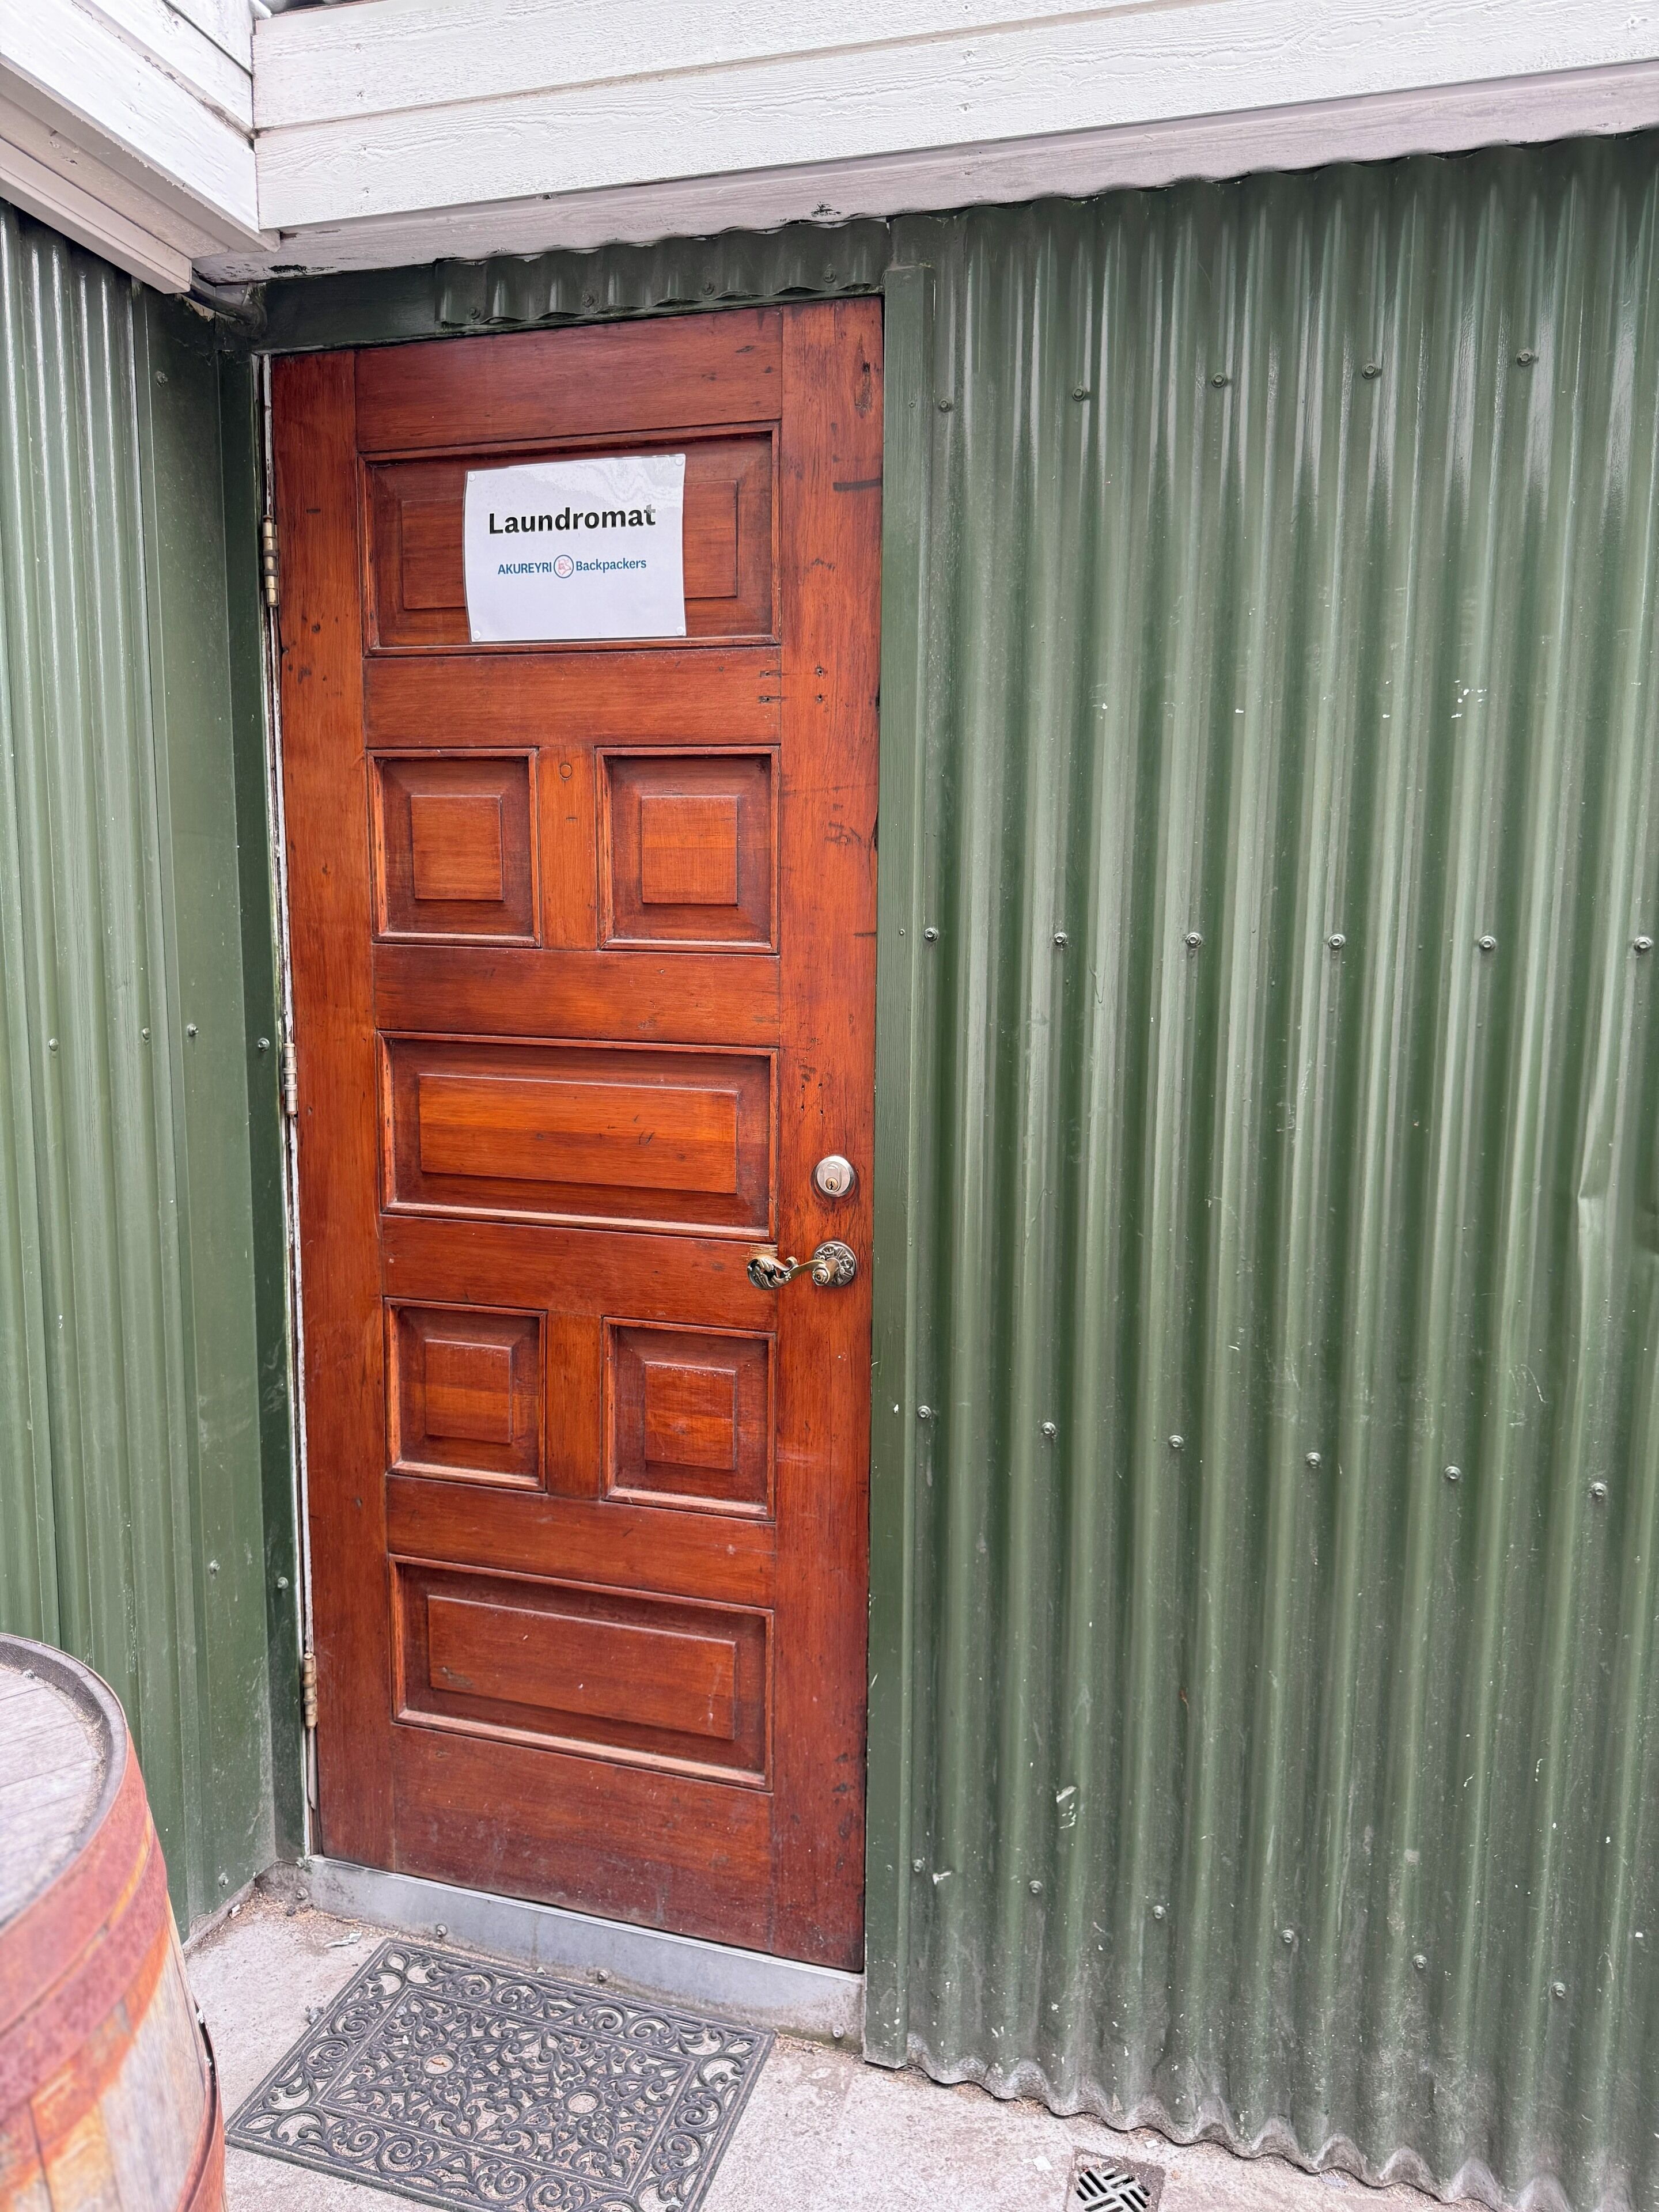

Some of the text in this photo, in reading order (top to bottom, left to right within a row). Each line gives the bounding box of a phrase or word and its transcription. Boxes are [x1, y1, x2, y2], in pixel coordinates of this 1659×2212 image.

[489, 504, 656, 535] Laundromat
[498, 558, 647, 574] AKUREYRI Backpackers
